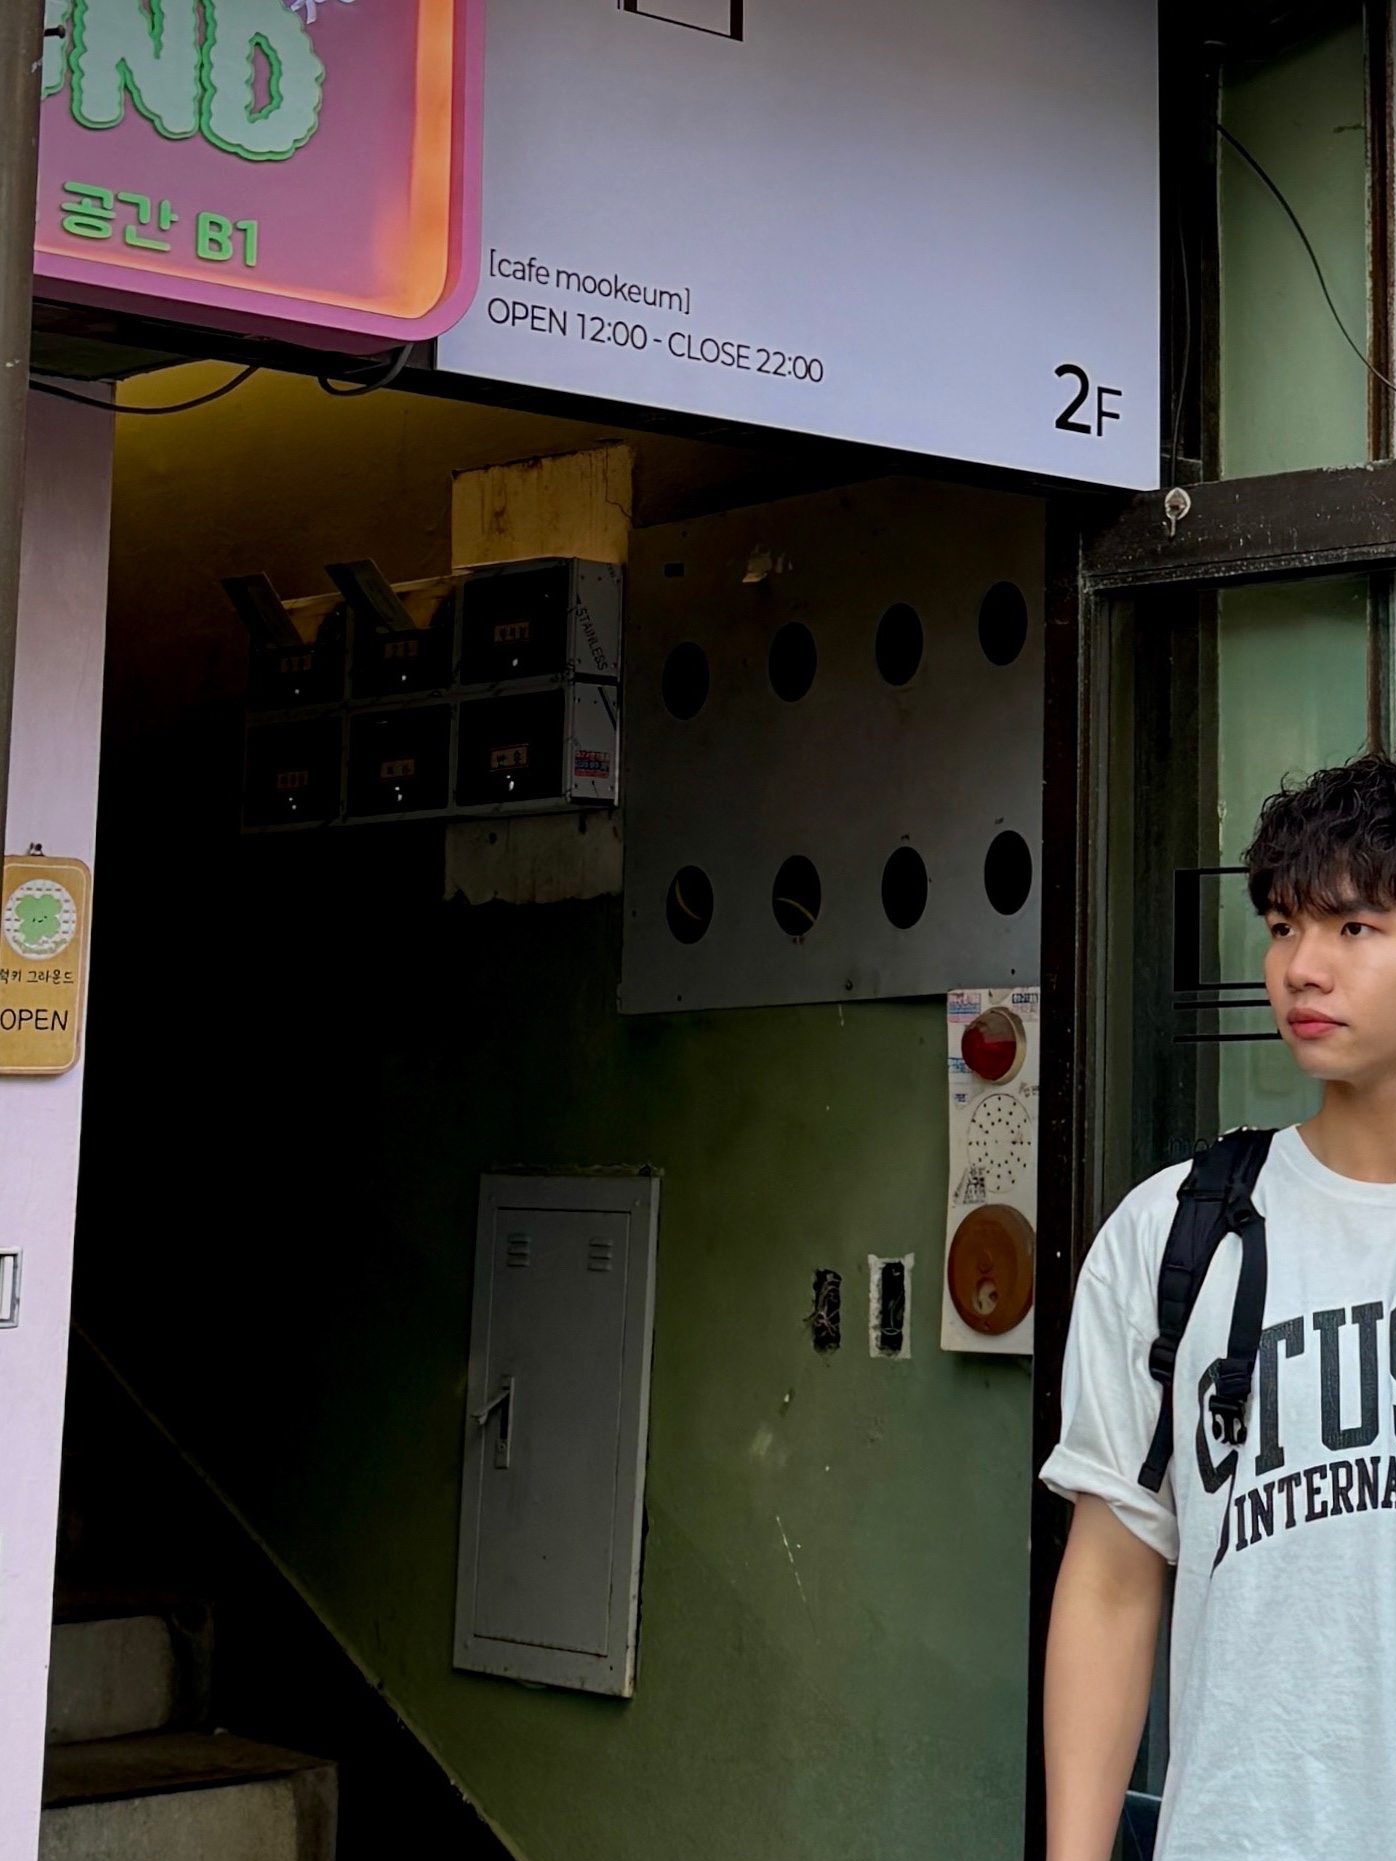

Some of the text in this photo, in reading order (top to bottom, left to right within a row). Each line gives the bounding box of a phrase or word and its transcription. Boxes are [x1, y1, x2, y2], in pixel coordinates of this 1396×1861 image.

[42, 0, 325, 161] ND
[61, 181, 258, 267] 공간 B1
[489, 248, 691, 315] [cafe mookeum]
[487, 297, 567, 336] OPEN
[576, 313, 648, 350] 12:00
[667, 331, 751, 370] CLOSE
[755, 348, 824, 383] 22:00
[1054, 363, 1123, 437] 2F
[0, 1008, 68, 1031] OPEN
